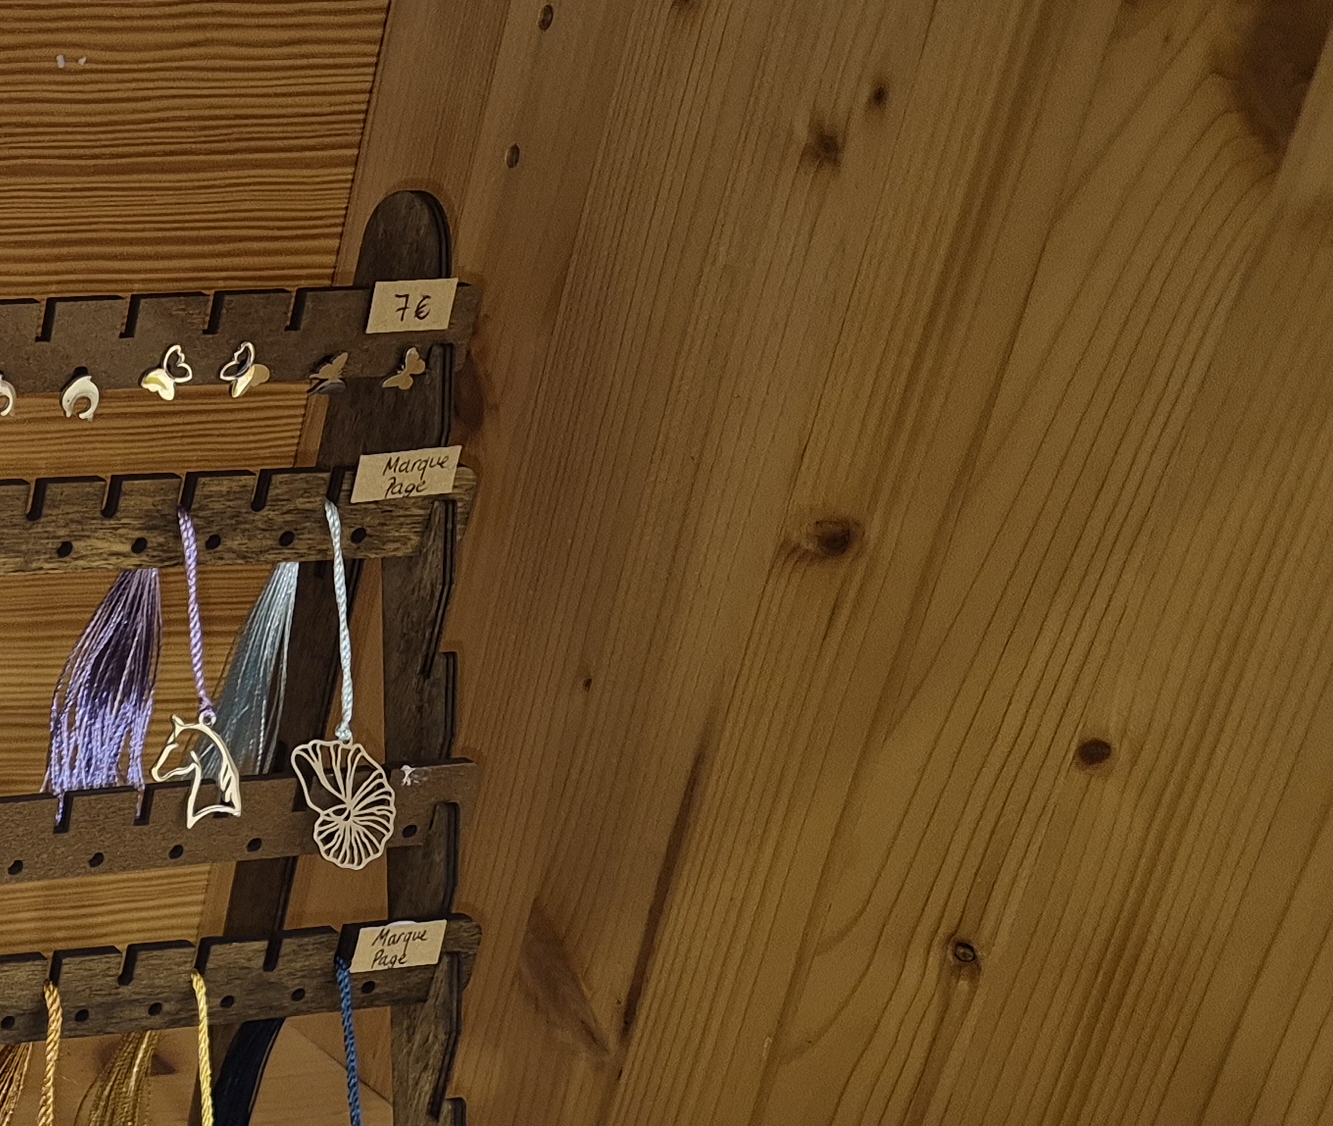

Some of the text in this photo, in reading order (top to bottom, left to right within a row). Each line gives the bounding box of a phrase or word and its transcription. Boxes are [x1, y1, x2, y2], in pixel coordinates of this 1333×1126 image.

[394, 293, 432, 322] 7€
[382, 454, 450, 481] Marque
[384, 476, 429, 499] Page
[371, 927, 429, 955] Marque
[371, 948, 410, 970] Page
